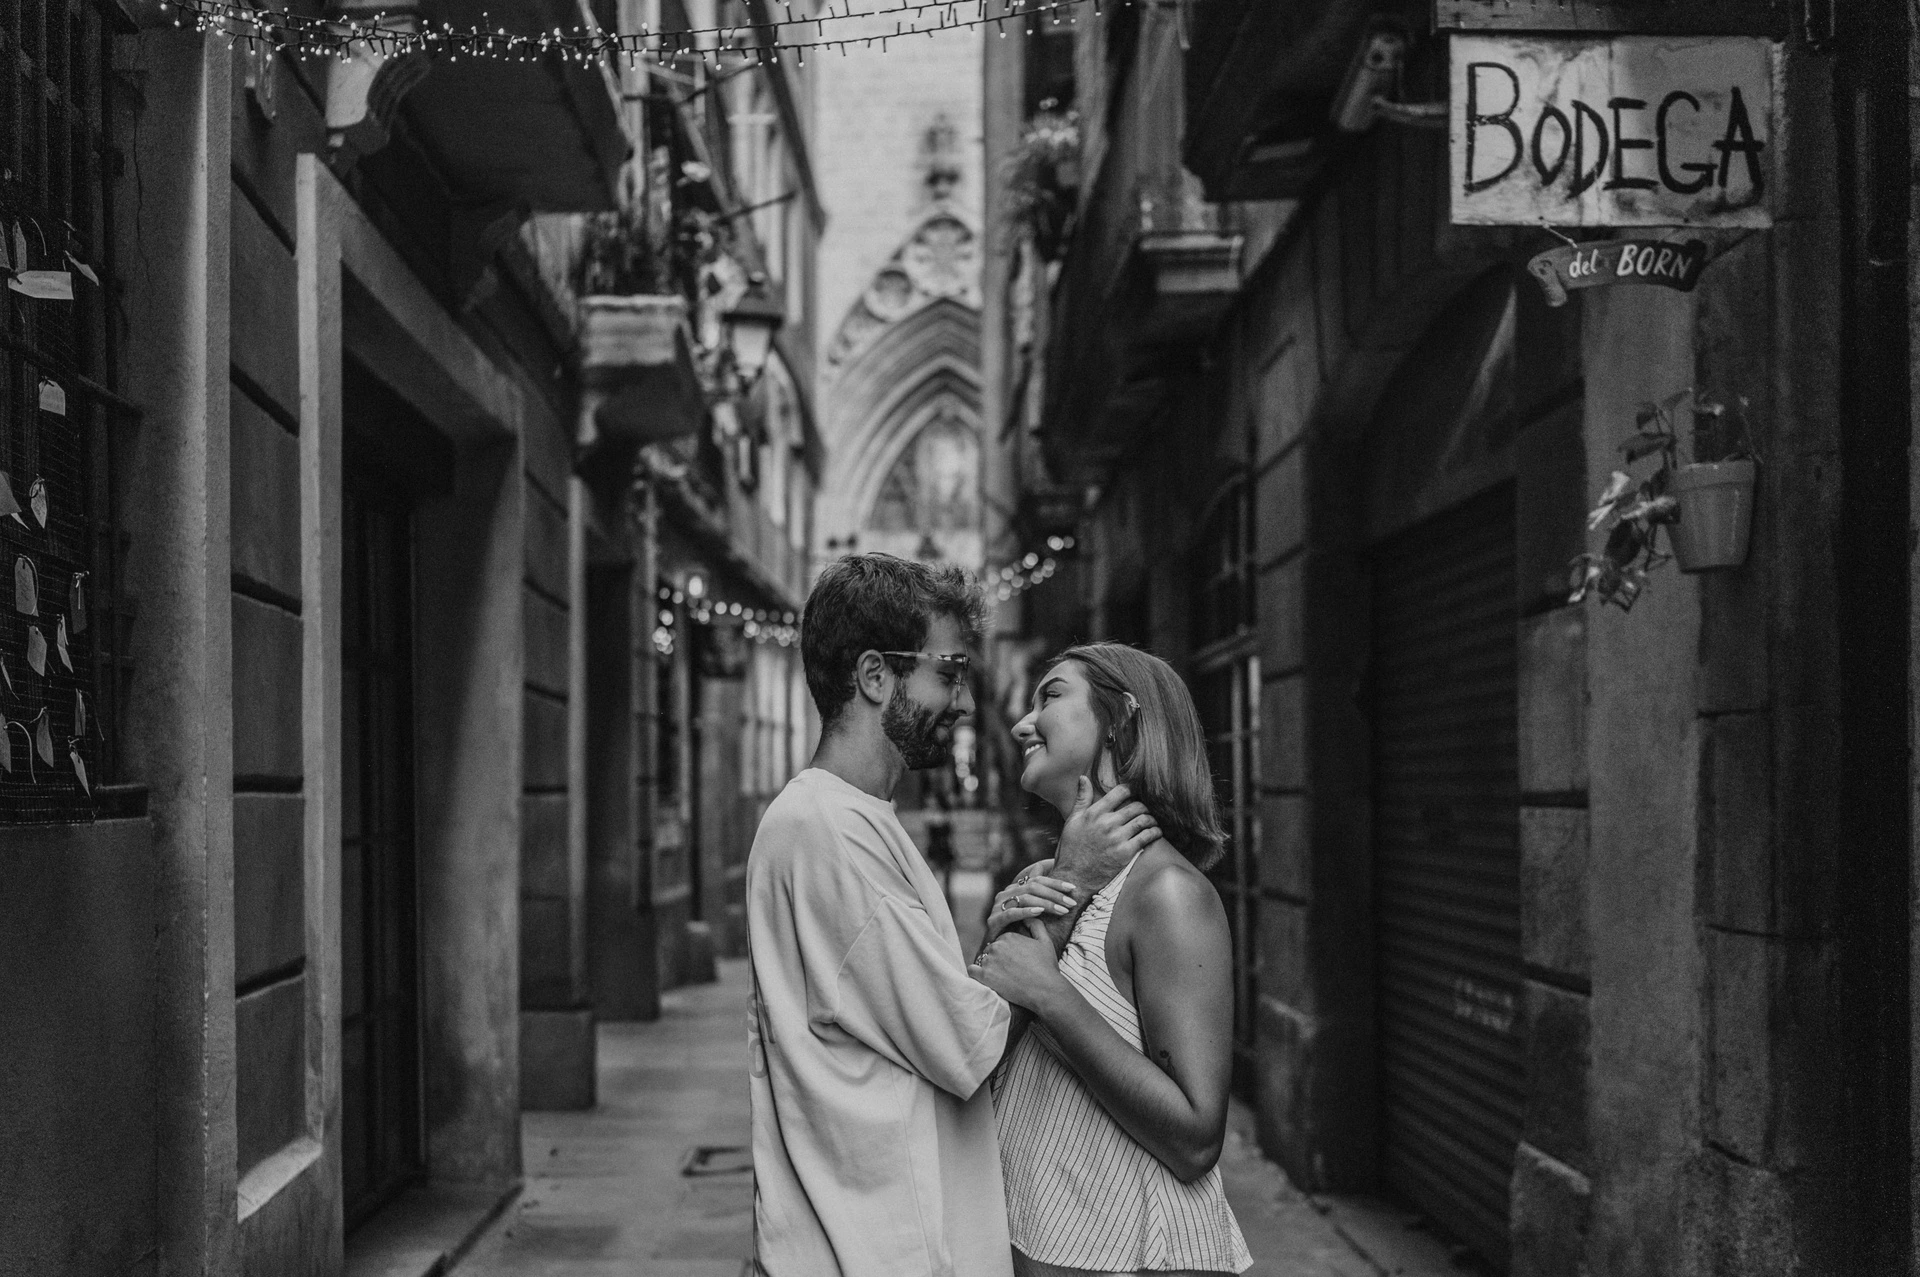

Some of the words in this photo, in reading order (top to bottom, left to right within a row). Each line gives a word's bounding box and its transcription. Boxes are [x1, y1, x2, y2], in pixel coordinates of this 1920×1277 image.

[1463, 61, 1766, 204] BODEGA
[1568, 251, 1599, 279] del
[1616, 243, 1694, 280] BORN
